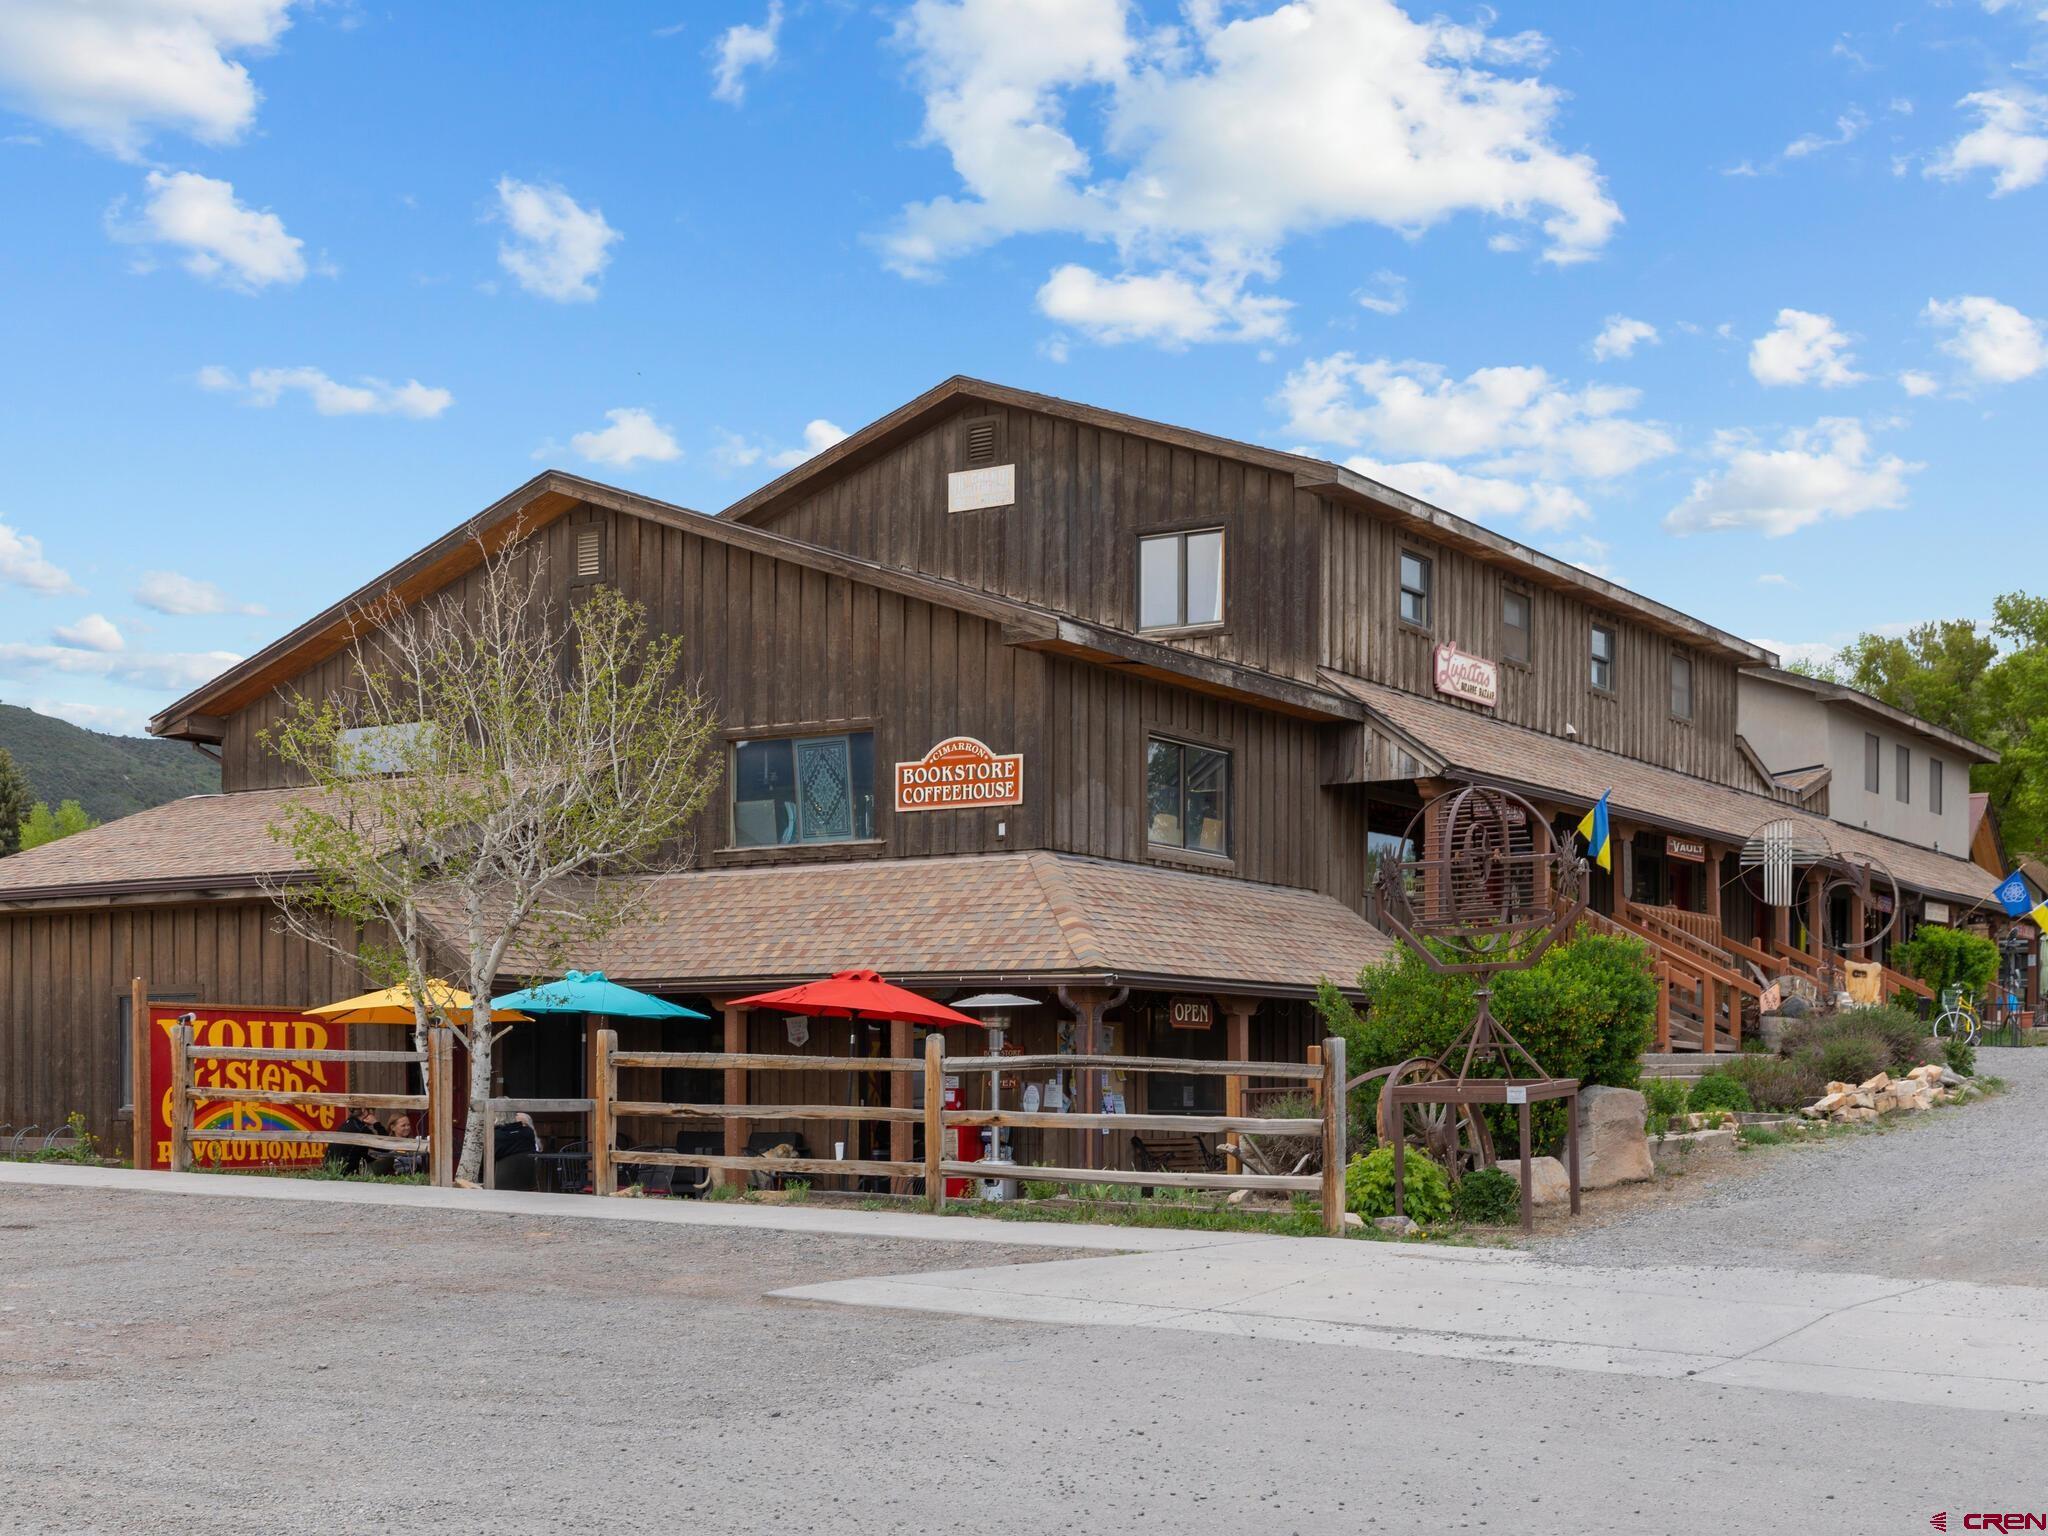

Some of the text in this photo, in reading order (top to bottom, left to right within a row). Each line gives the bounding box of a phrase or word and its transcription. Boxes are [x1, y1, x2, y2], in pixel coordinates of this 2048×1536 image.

[933, 742, 985, 761] CIMARRON
[903, 761, 1015, 785] BOOKSTORE
[902, 781, 1015, 804] COFFEEHOUSE
[1673, 840, 1704, 853] VAULT
[1174, 1003, 1209, 1023] OPEN
[983, 1049, 1022, 1057] BOSTORE
[987, 1079, 1016, 1087] OEN
[157, 1139, 330, 1164] RVOLUTIONAR
